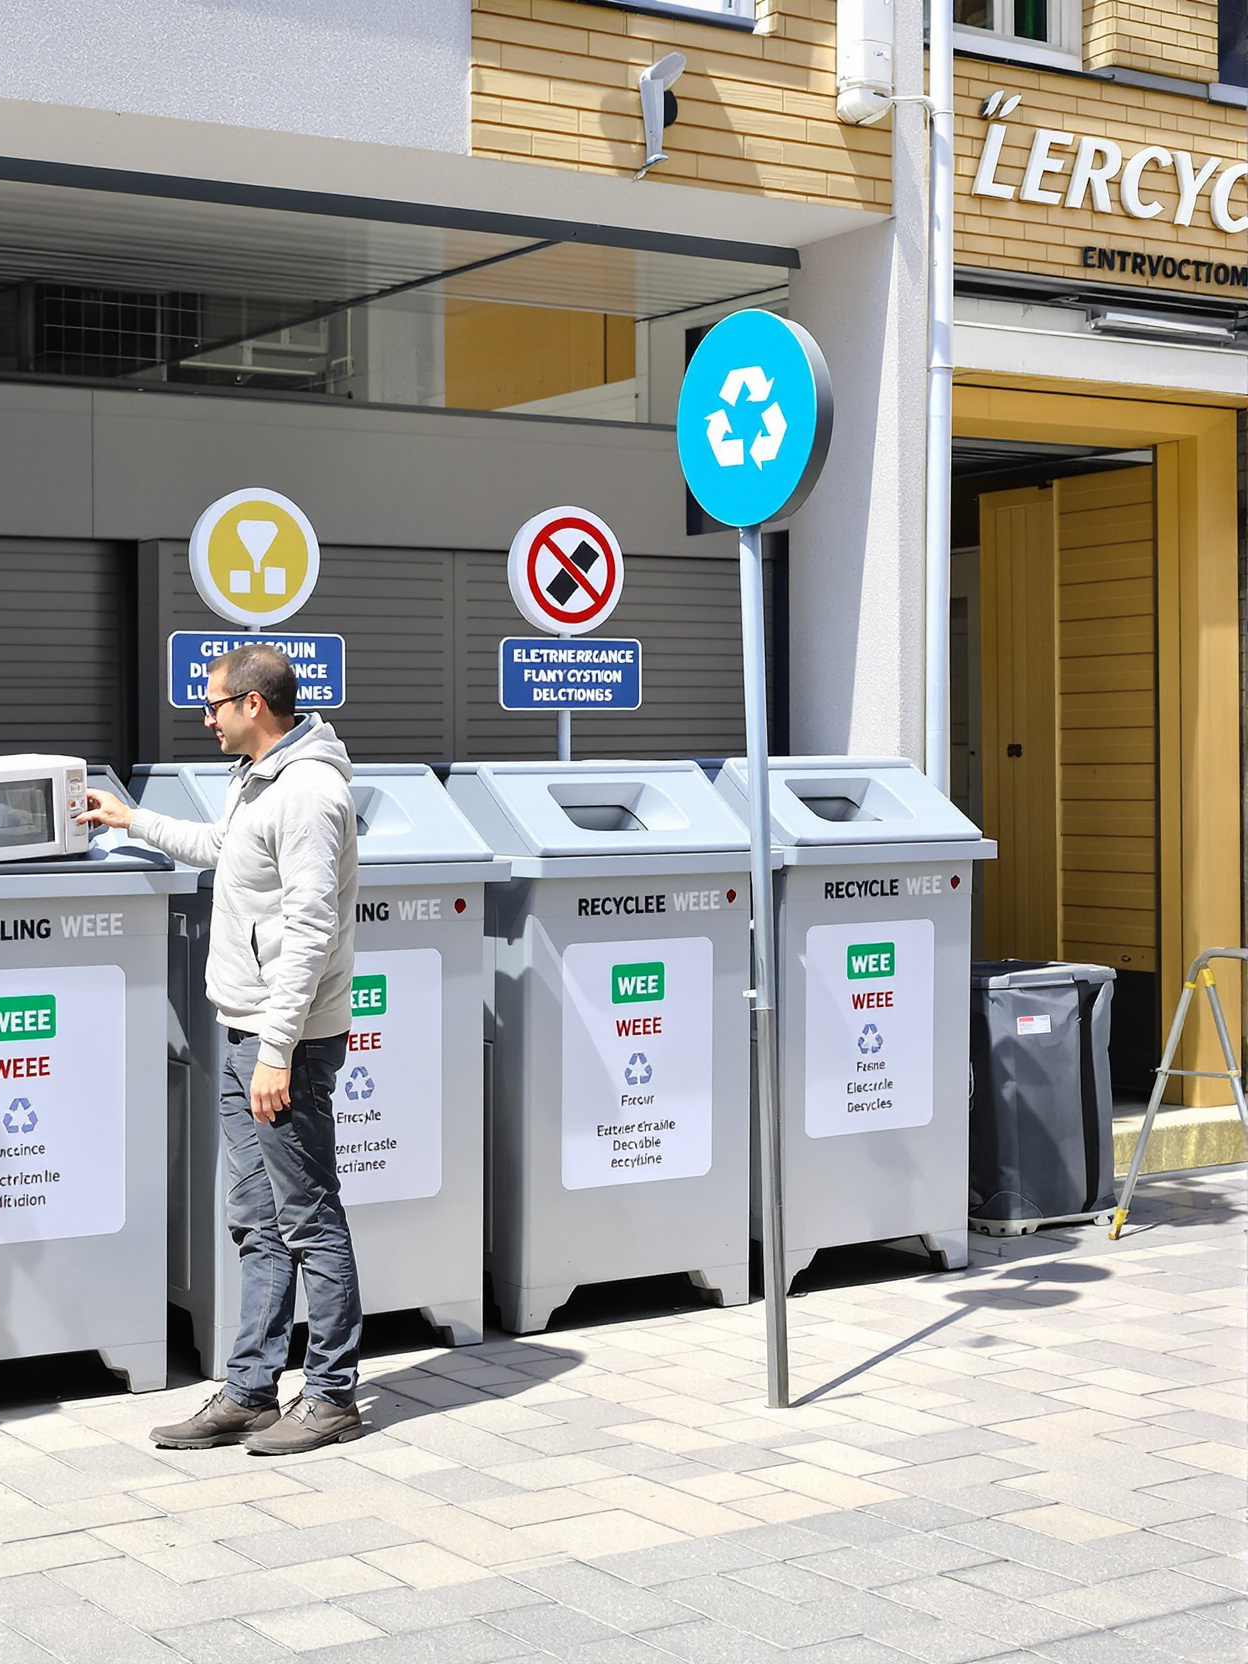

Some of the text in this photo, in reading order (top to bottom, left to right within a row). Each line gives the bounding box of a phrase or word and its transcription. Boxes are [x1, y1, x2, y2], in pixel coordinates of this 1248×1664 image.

[906, 875, 942, 896] WEE
[397, 898, 442, 921] WEE
[578, 890, 720, 916] RECYCLEE WEEE
[60, 912, 124, 938] WEEE
[851, 952, 891, 974] WEE
[617, 974, 659, 996] WEE
[349, 987, 383, 1009] EEE
[852, 991, 894, 1010] WEEE
[615, 1017, 663, 1037] WEEE
[348, 1031, 382, 1052] EEE
